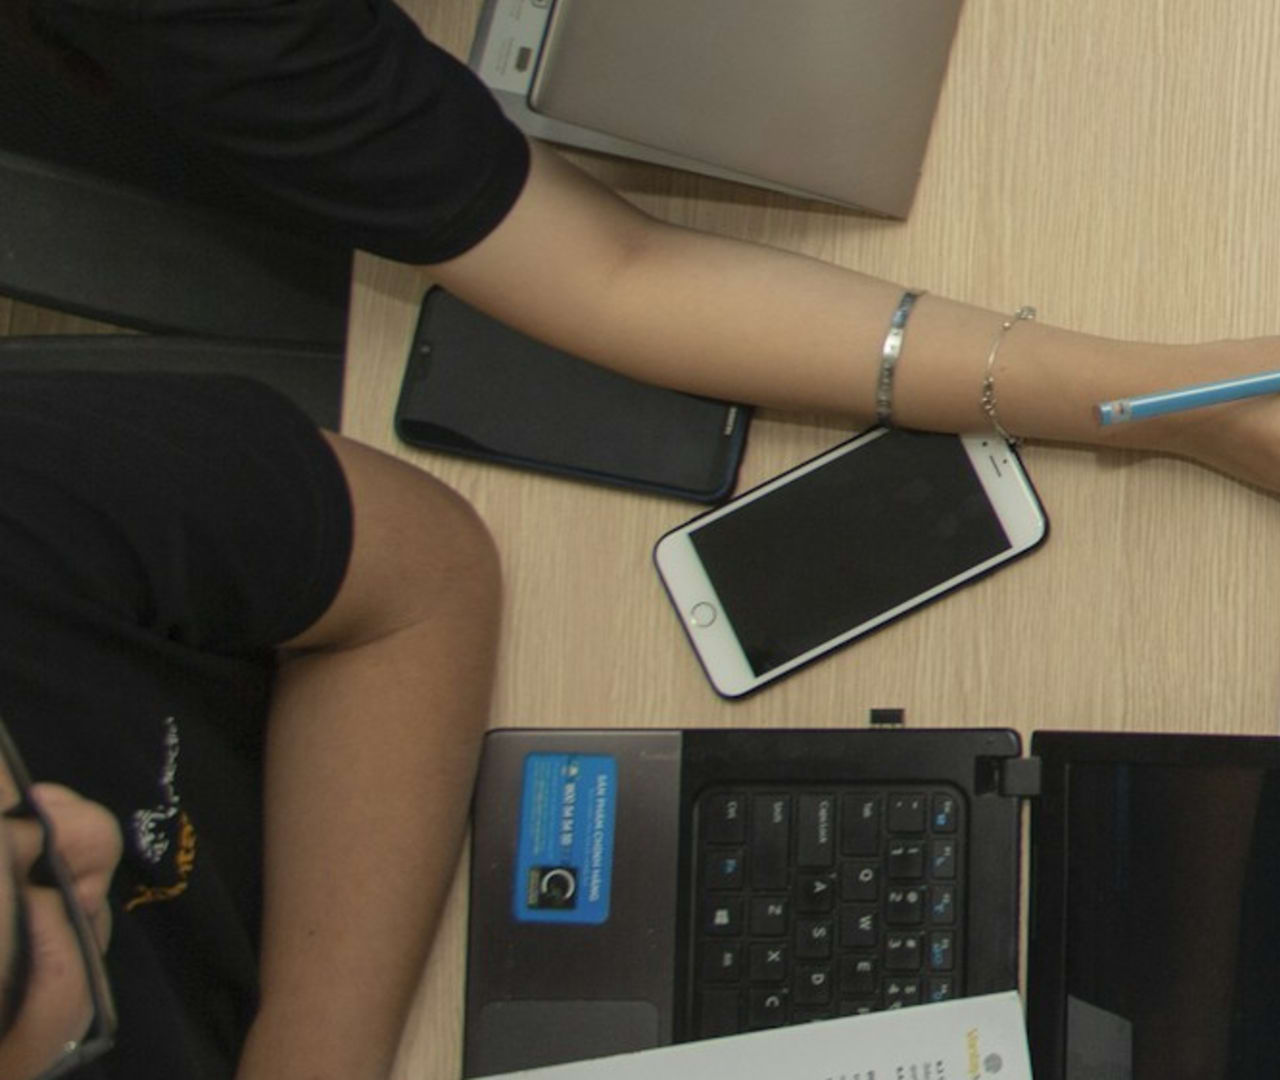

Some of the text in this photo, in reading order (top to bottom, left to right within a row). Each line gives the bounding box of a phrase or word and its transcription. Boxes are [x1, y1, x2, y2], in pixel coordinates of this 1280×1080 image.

[859, 869, 872, 881] Q
[813, 882, 828, 892] A
[859, 916, 872, 930] W
[812, 926, 826, 938] S
[768, 950, 780, 962] X
[857, 962, 871, 970] E
[812, 974, 824, 985] D
[766, 997, 779, 1008] C
